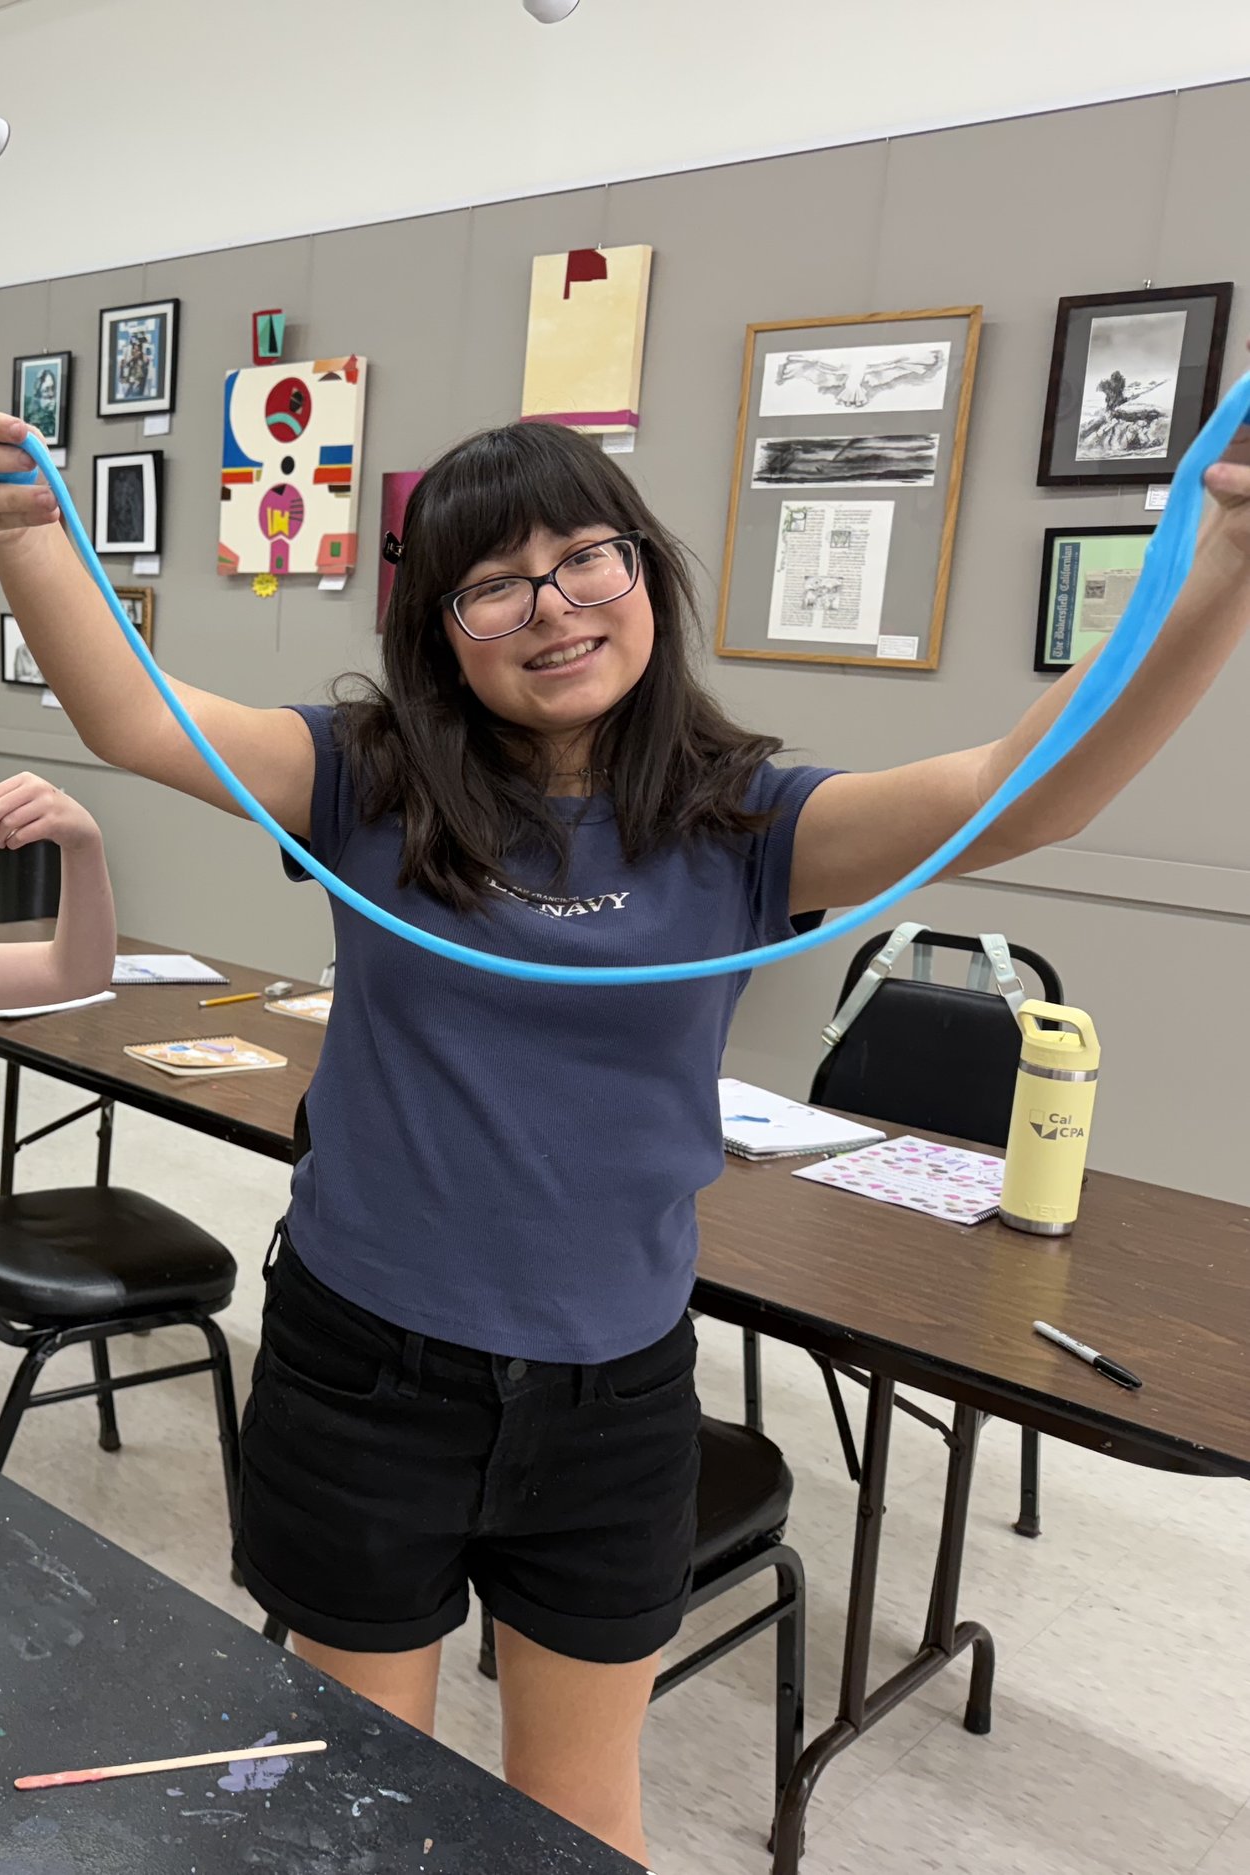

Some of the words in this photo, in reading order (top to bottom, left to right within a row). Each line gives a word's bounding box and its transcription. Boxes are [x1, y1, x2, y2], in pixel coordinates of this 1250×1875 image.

[1060, 545, 1073, 592] Californian
[540, 892, 630, 917] NAVY
[1049, 1113, 1072, 1125] Cal
[1060, 1127, 1084, 1138] CPA
[1024, 1201, 1067, 1219] YET
